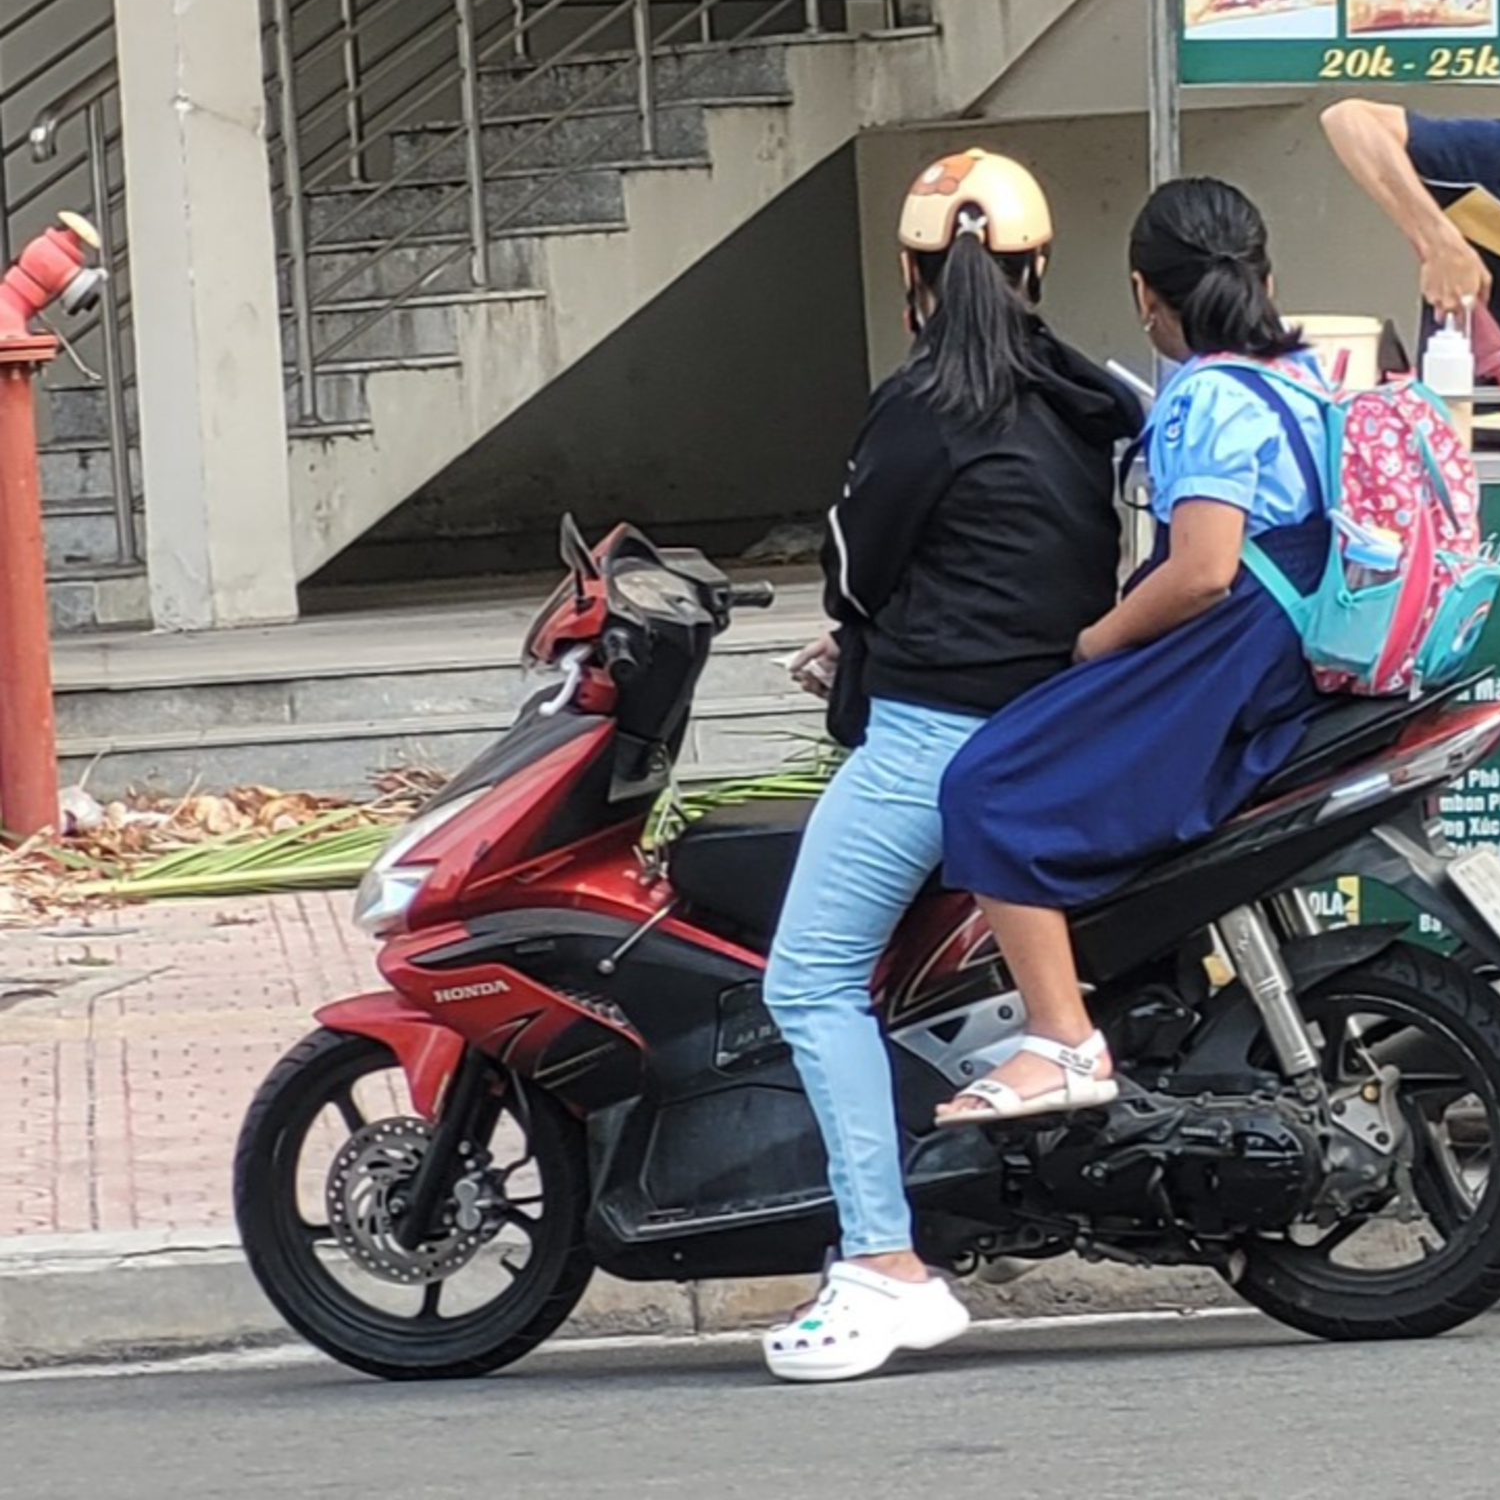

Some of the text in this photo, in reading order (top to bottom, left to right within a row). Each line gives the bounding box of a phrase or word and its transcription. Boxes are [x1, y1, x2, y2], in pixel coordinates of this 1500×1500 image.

[1319, 46, 1395, 77] 20k
[1425, 46, 1500, 76] 25k
[432, 979, 511, 1003] HONDA
